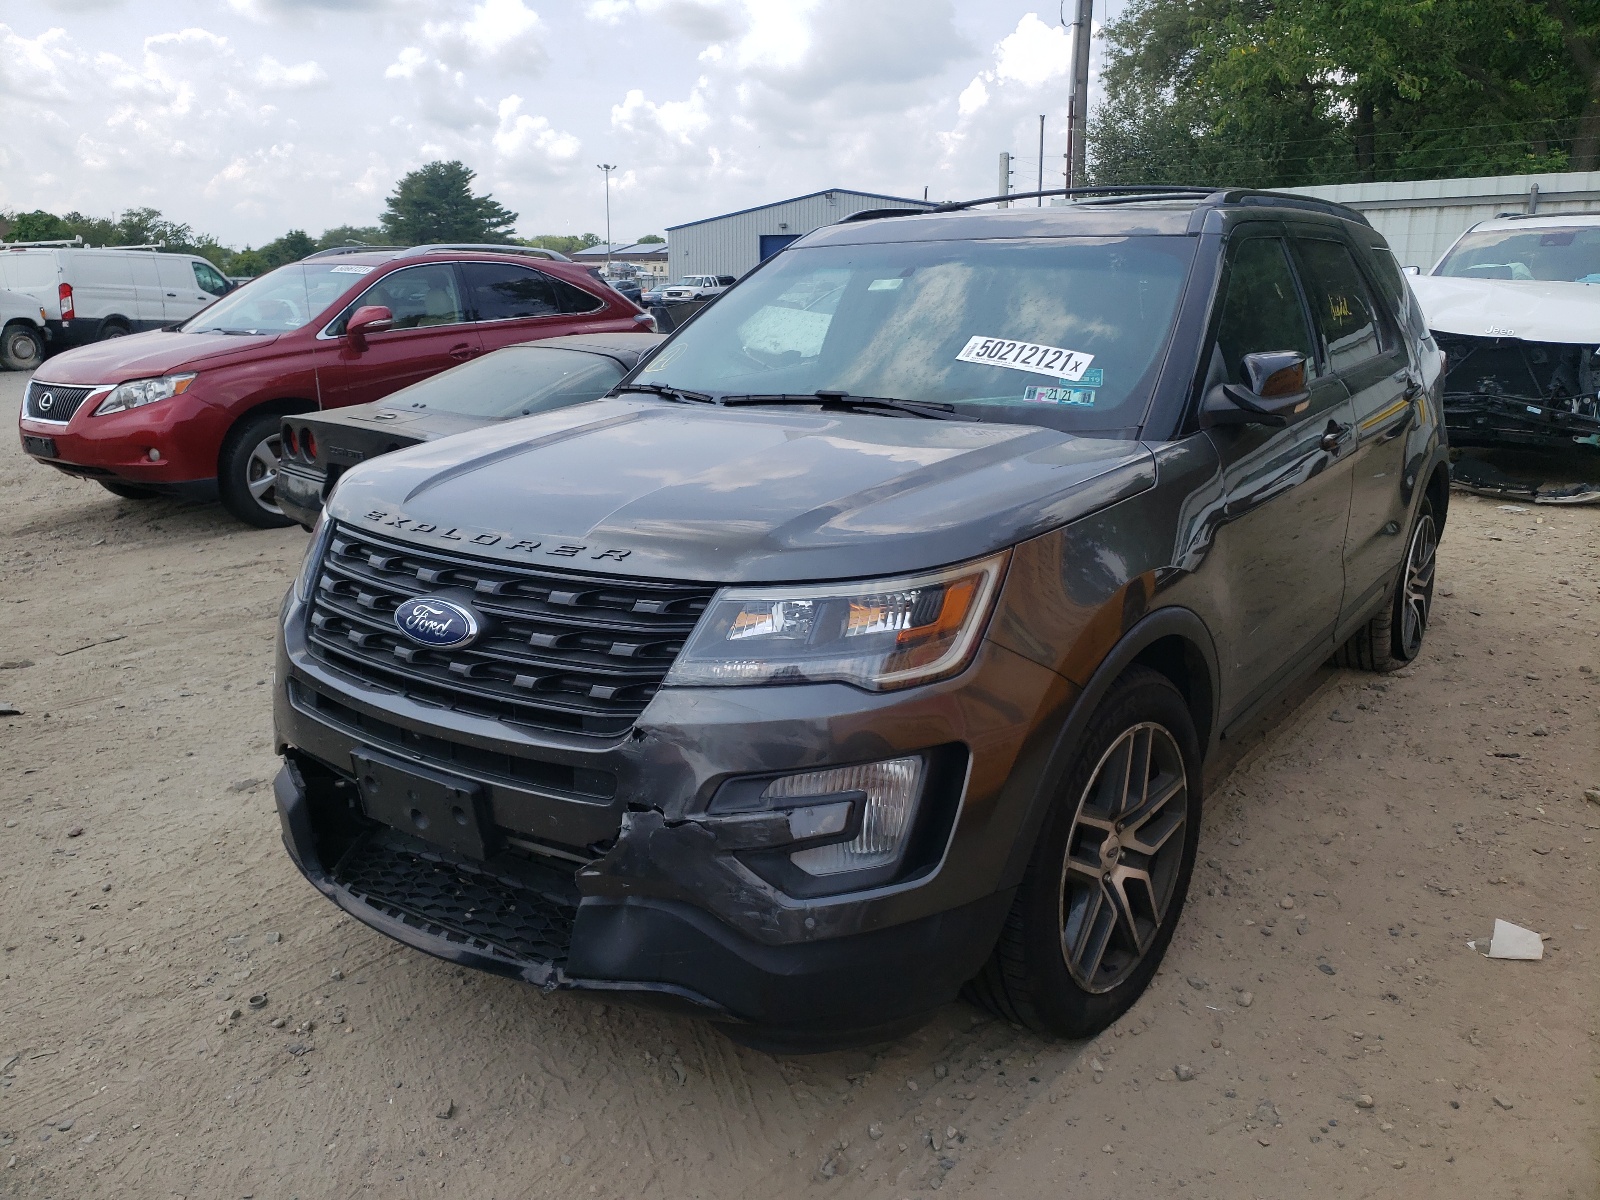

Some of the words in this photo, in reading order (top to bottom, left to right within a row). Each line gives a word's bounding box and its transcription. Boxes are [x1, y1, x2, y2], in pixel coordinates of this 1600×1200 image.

[1047, 388, 1058, 400] 21
[1061, 390, 1072, 402] 21
[364, 509, 633, 562] EXPLORER
[405, 603, 454, 638] Ford
